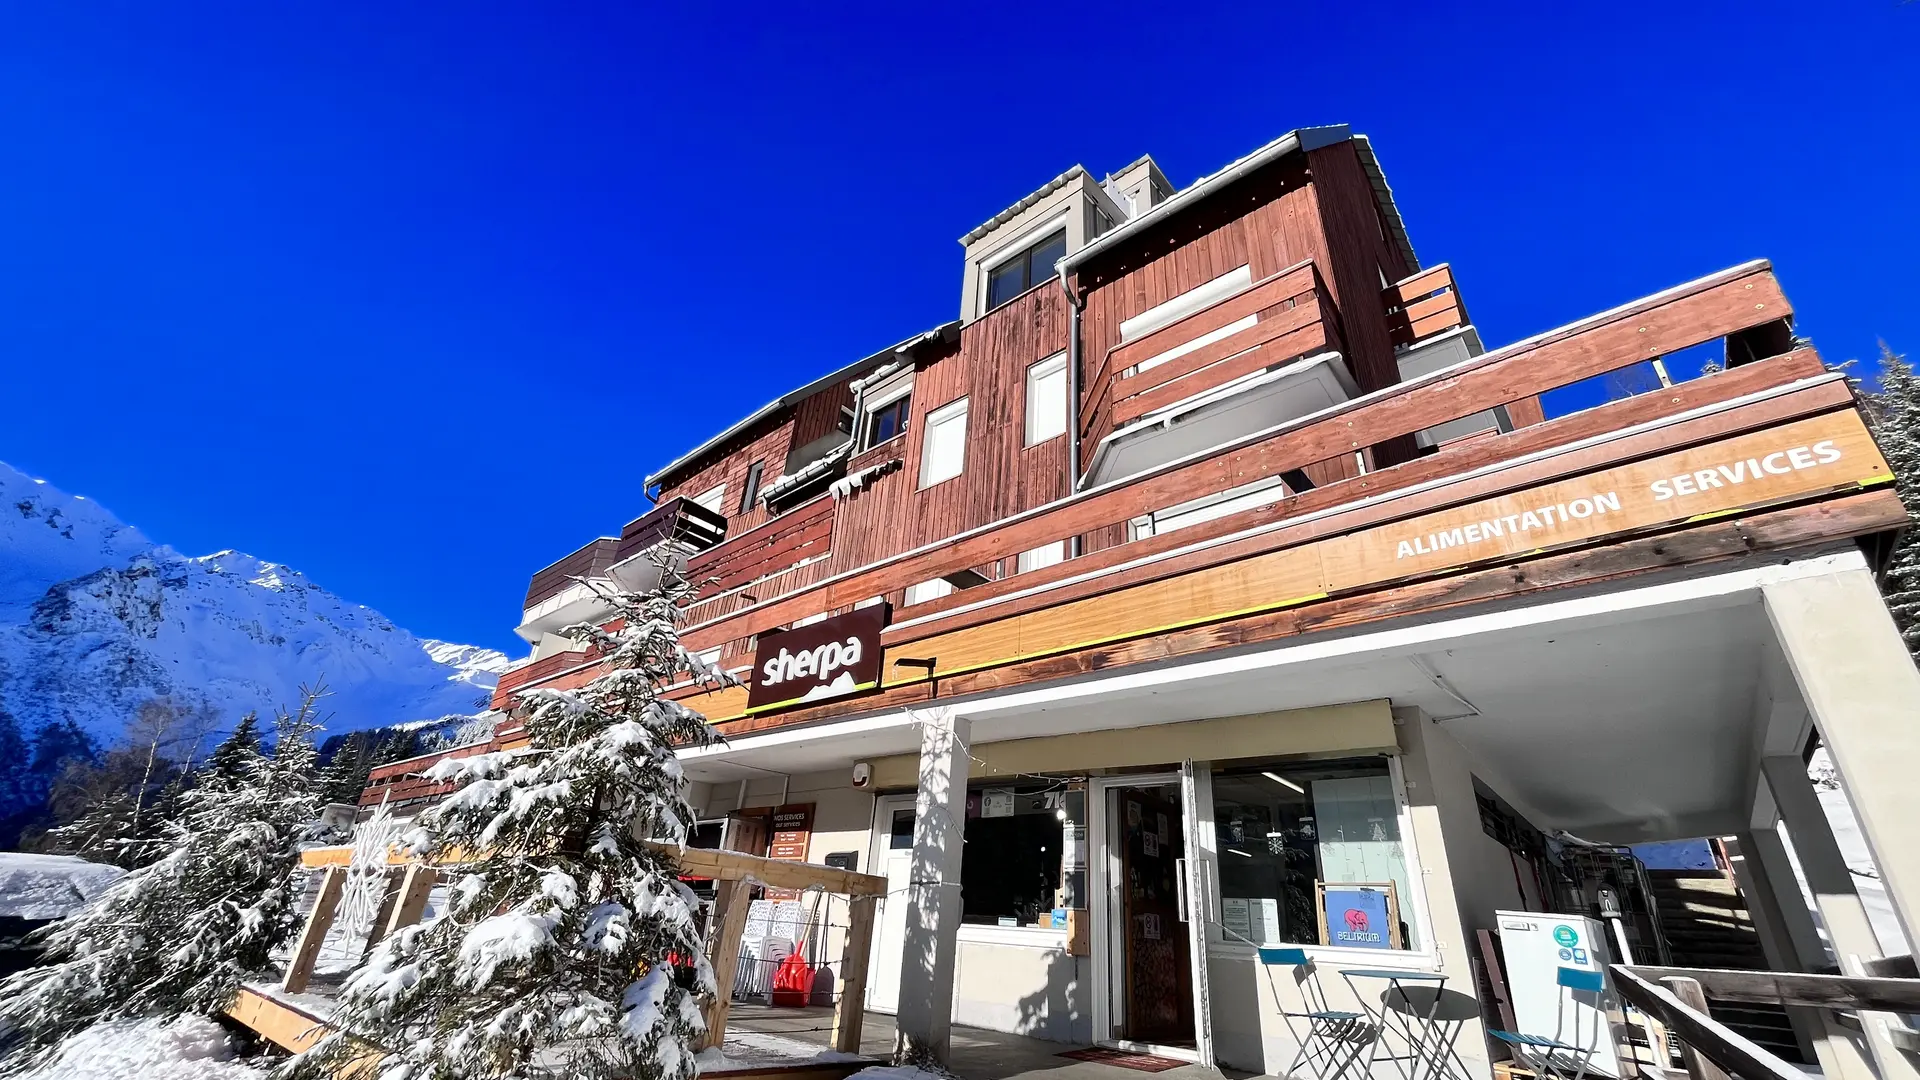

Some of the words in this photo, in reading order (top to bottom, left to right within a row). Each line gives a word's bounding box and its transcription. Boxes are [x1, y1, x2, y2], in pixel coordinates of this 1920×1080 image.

[1396, 490, 1621, 560] ALIMENTATION
[1650, 439, 1842, 502] SERVICES
[761, 636, 862, 686] sherpa
[784, 813, 805, 821] SERVICES
